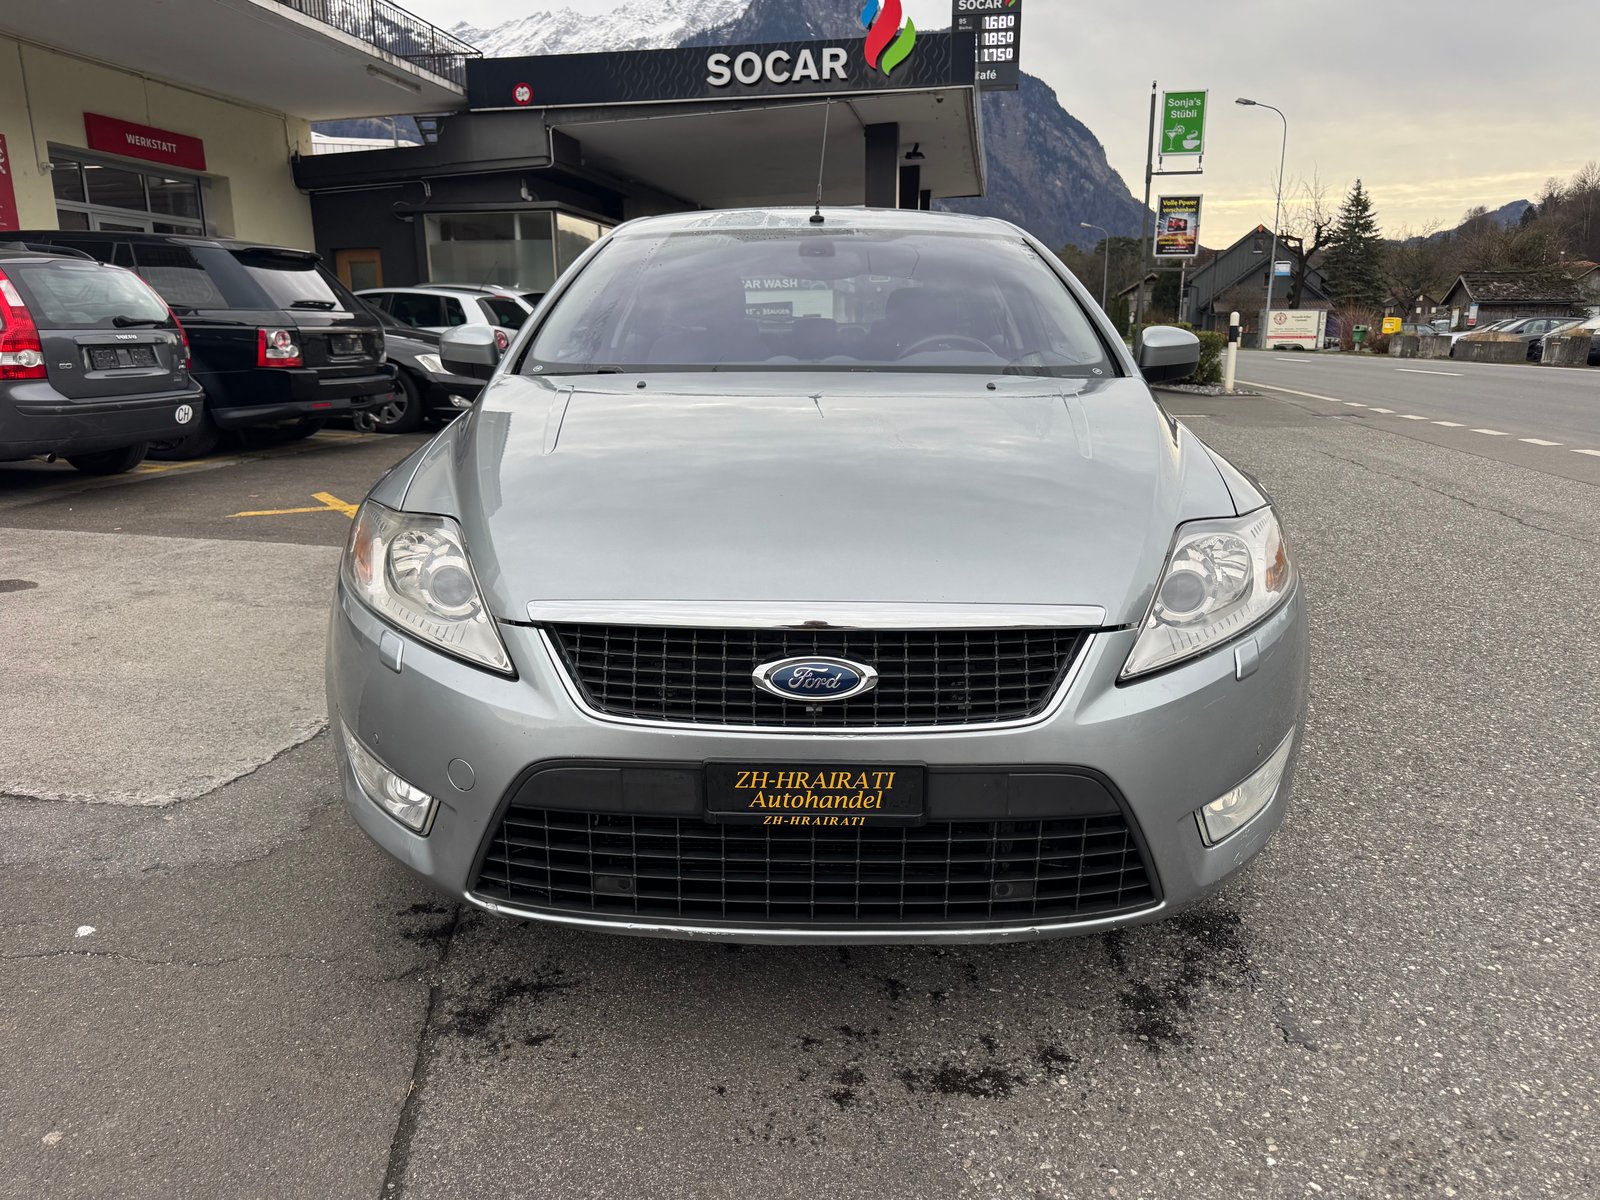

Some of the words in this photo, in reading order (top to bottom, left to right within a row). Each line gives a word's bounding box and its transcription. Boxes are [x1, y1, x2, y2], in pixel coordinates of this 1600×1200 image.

[958, 0, 1002, 10] SOCAR
[706, 47, 849, 86] SOCAR
[1168, 98, 1201, 108] Sonja's
[1171, 110, 1197, 118] Stübli
[125, 133, 177, 153] WERKSTATT
[742, 279, 761, 289] AR
[763, 278, 798, 289] WASH
[177, 407, 189, 422] CH
[788, 666, 842, 689] Ford
